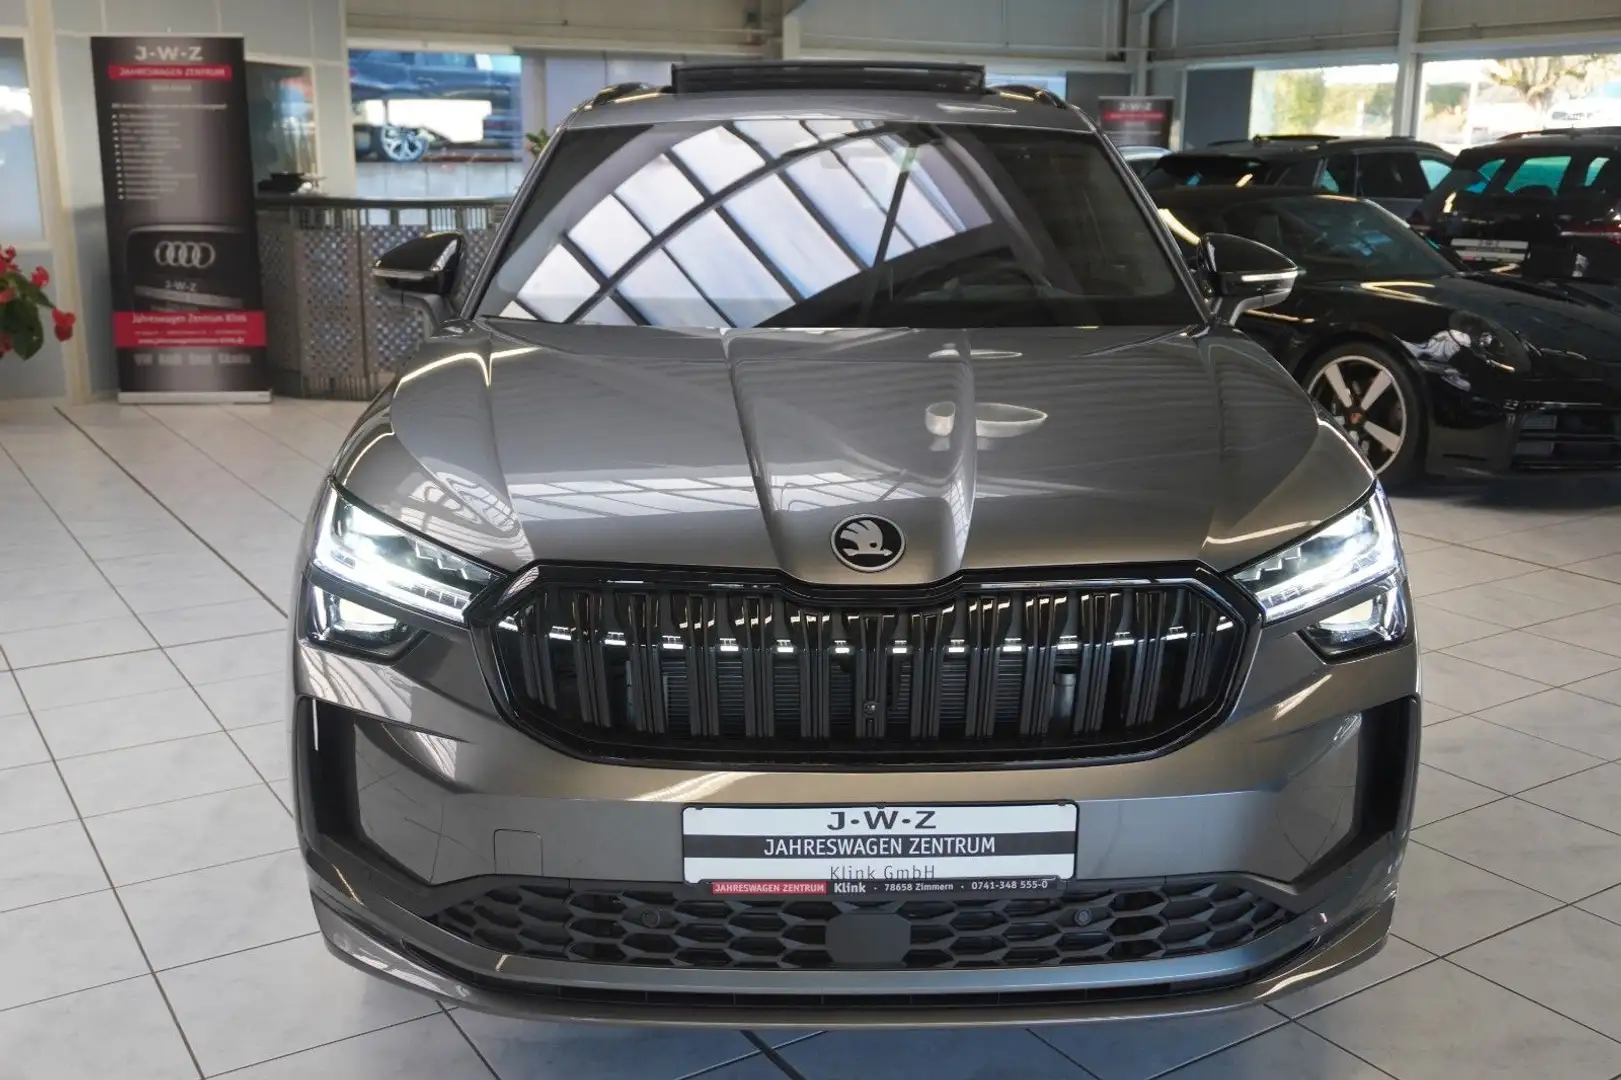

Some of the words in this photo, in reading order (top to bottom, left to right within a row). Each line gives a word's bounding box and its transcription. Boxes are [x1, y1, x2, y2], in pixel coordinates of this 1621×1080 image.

[763, 838, 902, 856] JAHRESWAGEN
[908, 836, 995, 855] ZENTRUM
[830, 865, 876, 880] Klink
[883, 865, 936, 880] GmbH
[714, 883, 780, 893] JAHRESWAGEN
[782, 883, 825, 892] ZENTRUM
[833, 882, 867, 893] Klink
[884, 883, 913, 892] 78658
[915, 882, 954, 892] Zimmern
[971, 881, 1018, 890] 0741-348
[1020, 880, 1049, 889] 555-0
